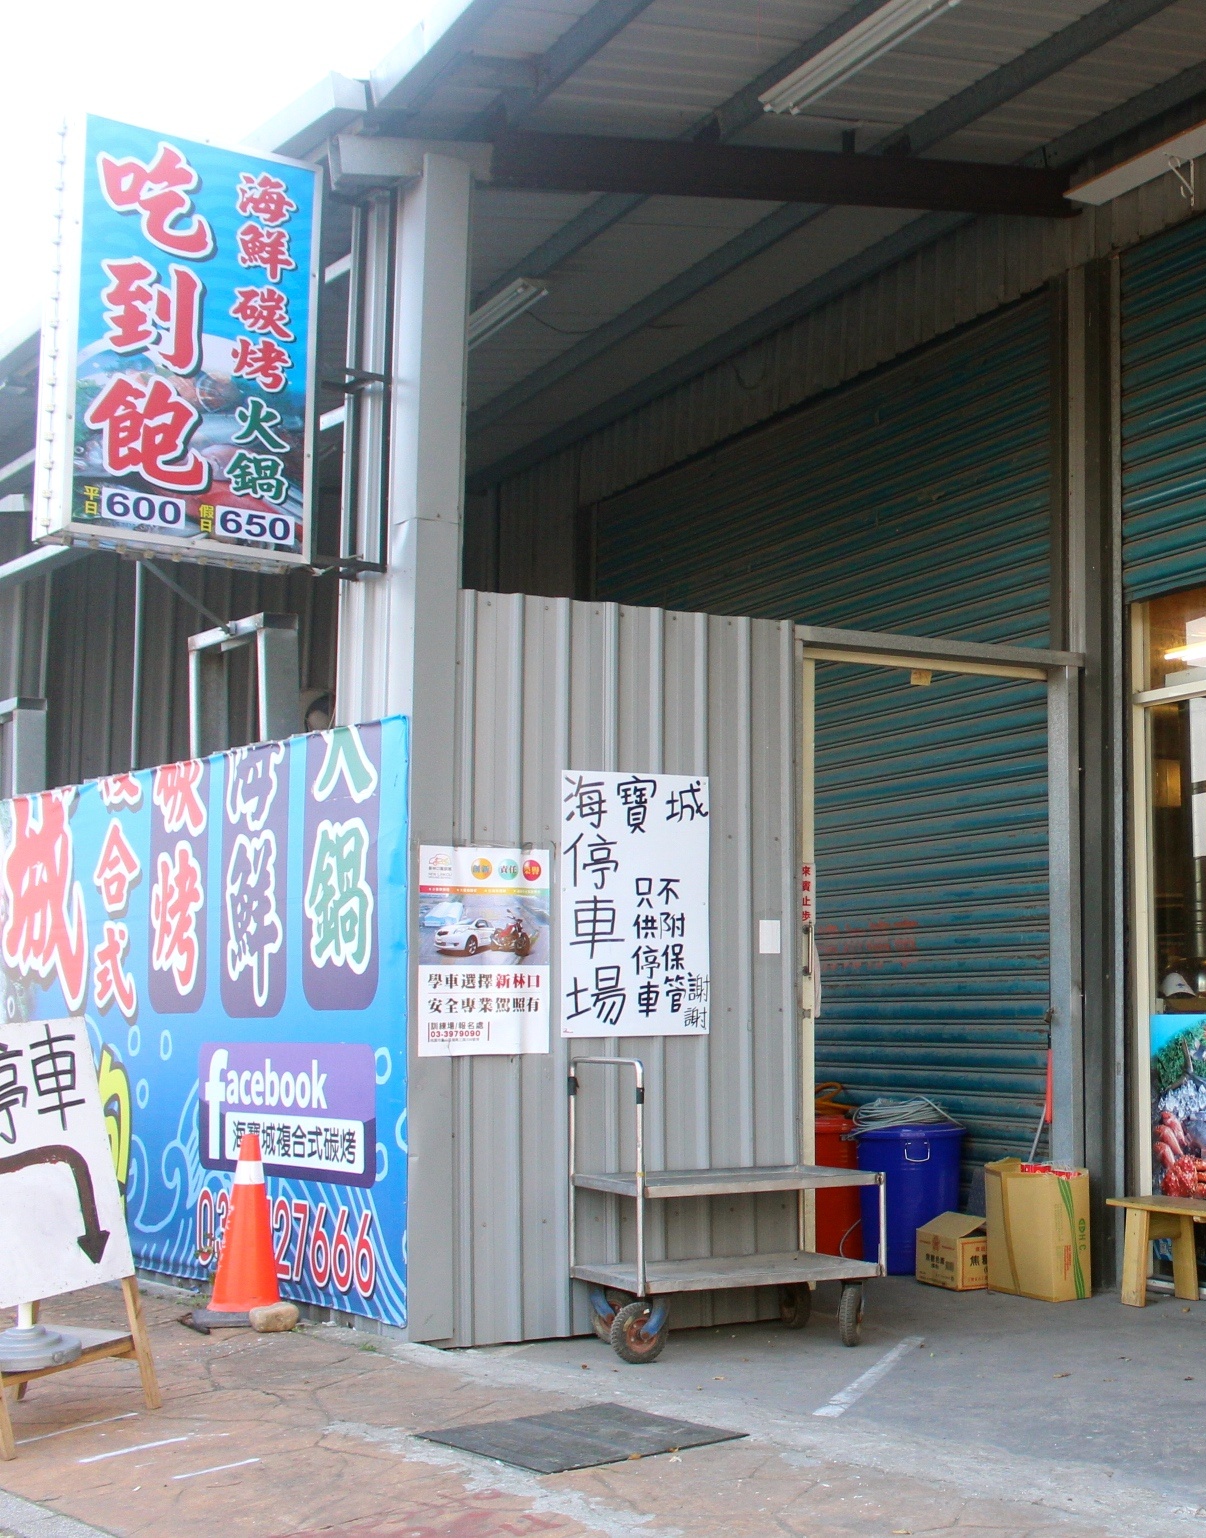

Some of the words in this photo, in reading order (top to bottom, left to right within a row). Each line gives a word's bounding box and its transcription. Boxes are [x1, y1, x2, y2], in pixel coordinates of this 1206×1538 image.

[85, 142, 212, 491] 吃到飽
[83, 485, 100, 516] 平日
[106, 492, 182, 525] 600
[199, 504, 214, 533] 假日
[219, 510, 291, 541] 650
[564, 775, 709, 834] 海寶城
[563, 833, 627, 1025] 停車場
[631, 877, 660, 1018] 只供停車
[657, 878, 687, 1014] 不附保管
[428, 973, 541, 989] 學車選擇新林口
[430, 1030, 481, 1038] 03-3979090
[205, 1048, 328, 1160] facebook
